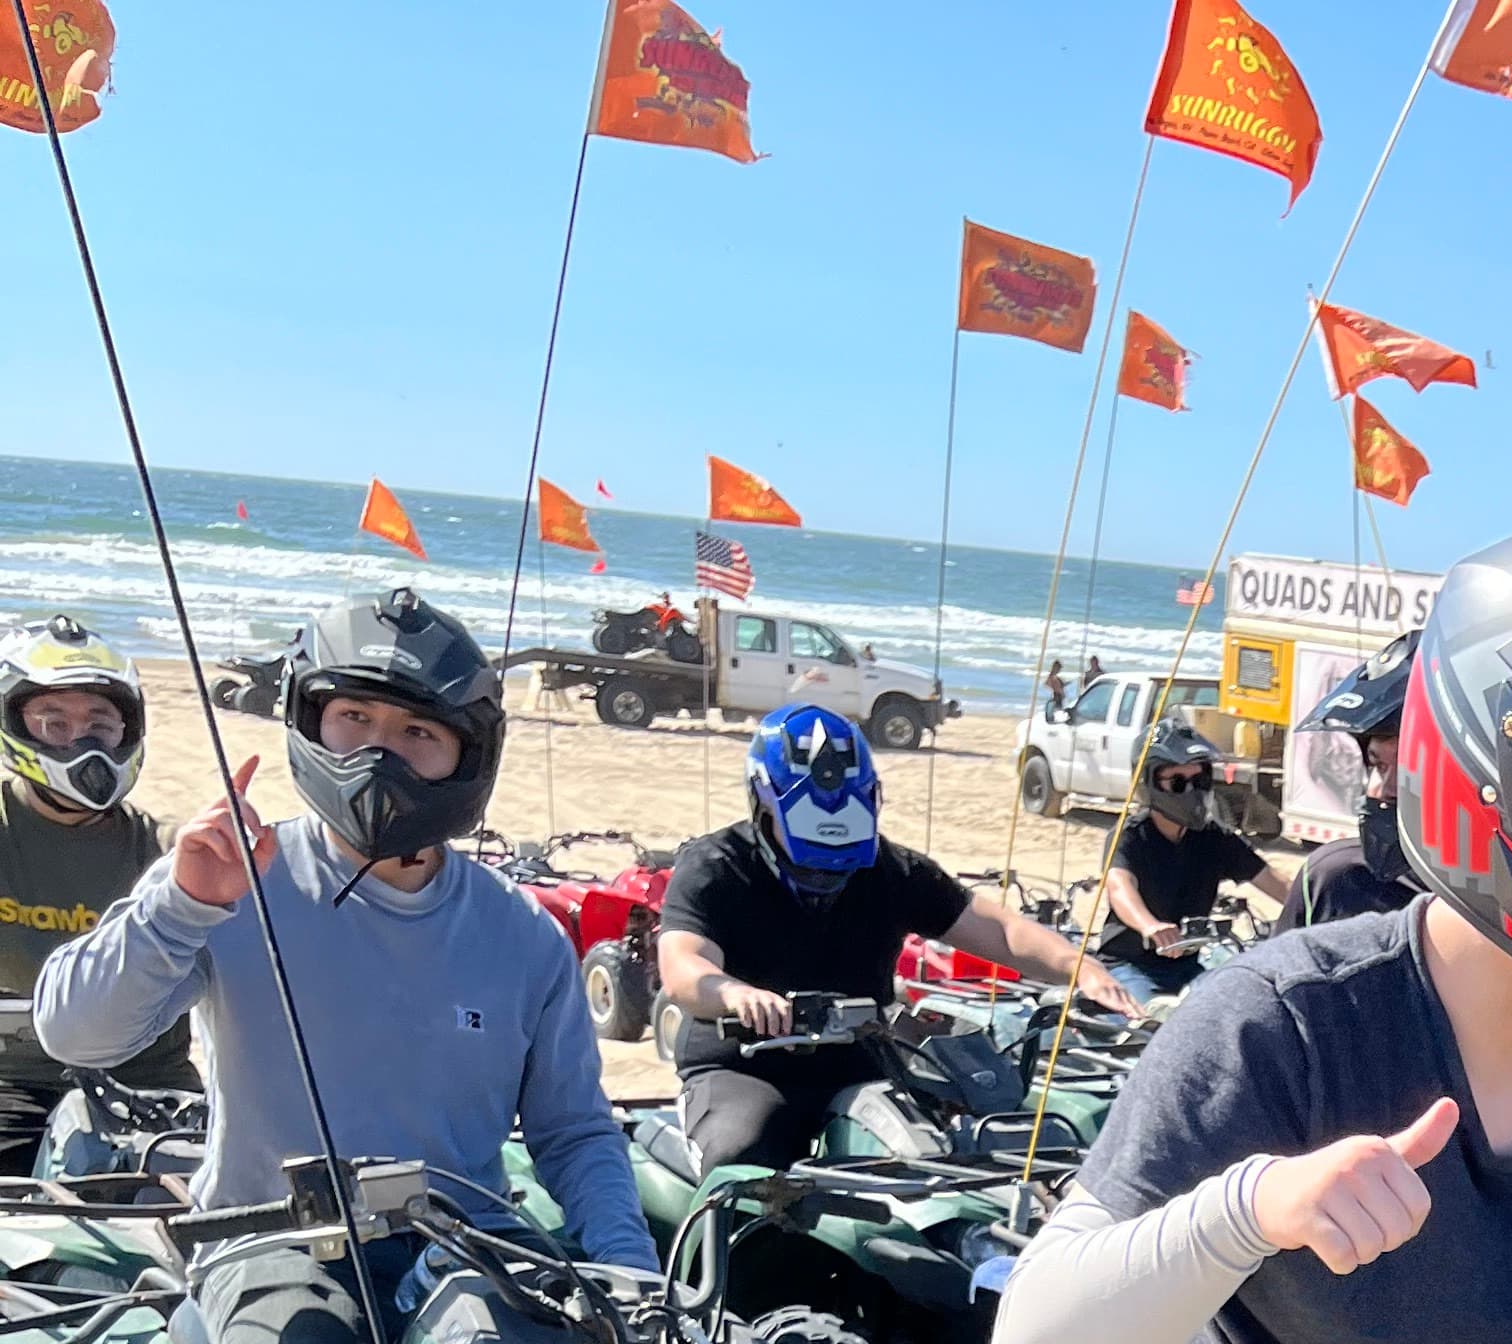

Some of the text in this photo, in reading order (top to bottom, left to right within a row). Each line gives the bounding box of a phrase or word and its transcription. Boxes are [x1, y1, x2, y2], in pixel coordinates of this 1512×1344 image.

[1172, 94, 1297, 154] SUNBUGGY
[1241, 568, 1332, 613] QUADS
[1340, 581, 1401, 622] AND
